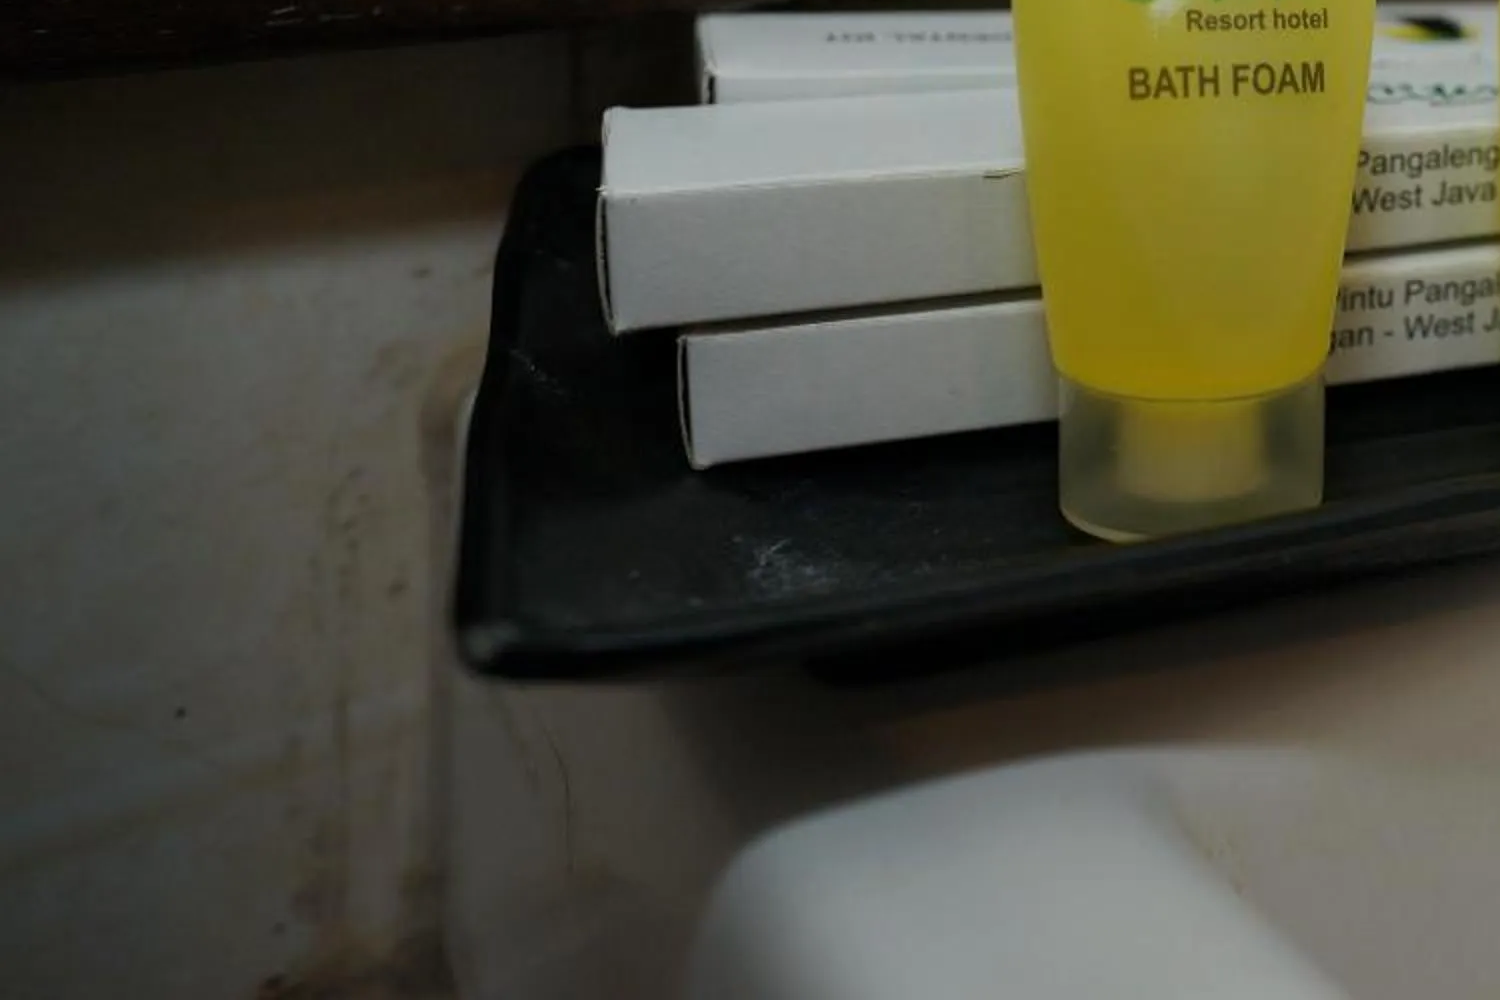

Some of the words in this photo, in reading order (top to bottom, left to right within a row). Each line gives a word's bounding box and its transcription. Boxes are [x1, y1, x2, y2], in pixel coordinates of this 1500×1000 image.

[1186, 8, 1266, 33] Resort
[1273, 7, 1328, 30] hotel
[1129, 64, 1220, 101] BATH
[1232, 61, 1326, 97] FOAM
[1352, 184, 1422, 214] West
[1431, 179, 1498, 206] Java
[1336, 285, 1394, 312] intu
[1404, 312, 1474, 341] West
